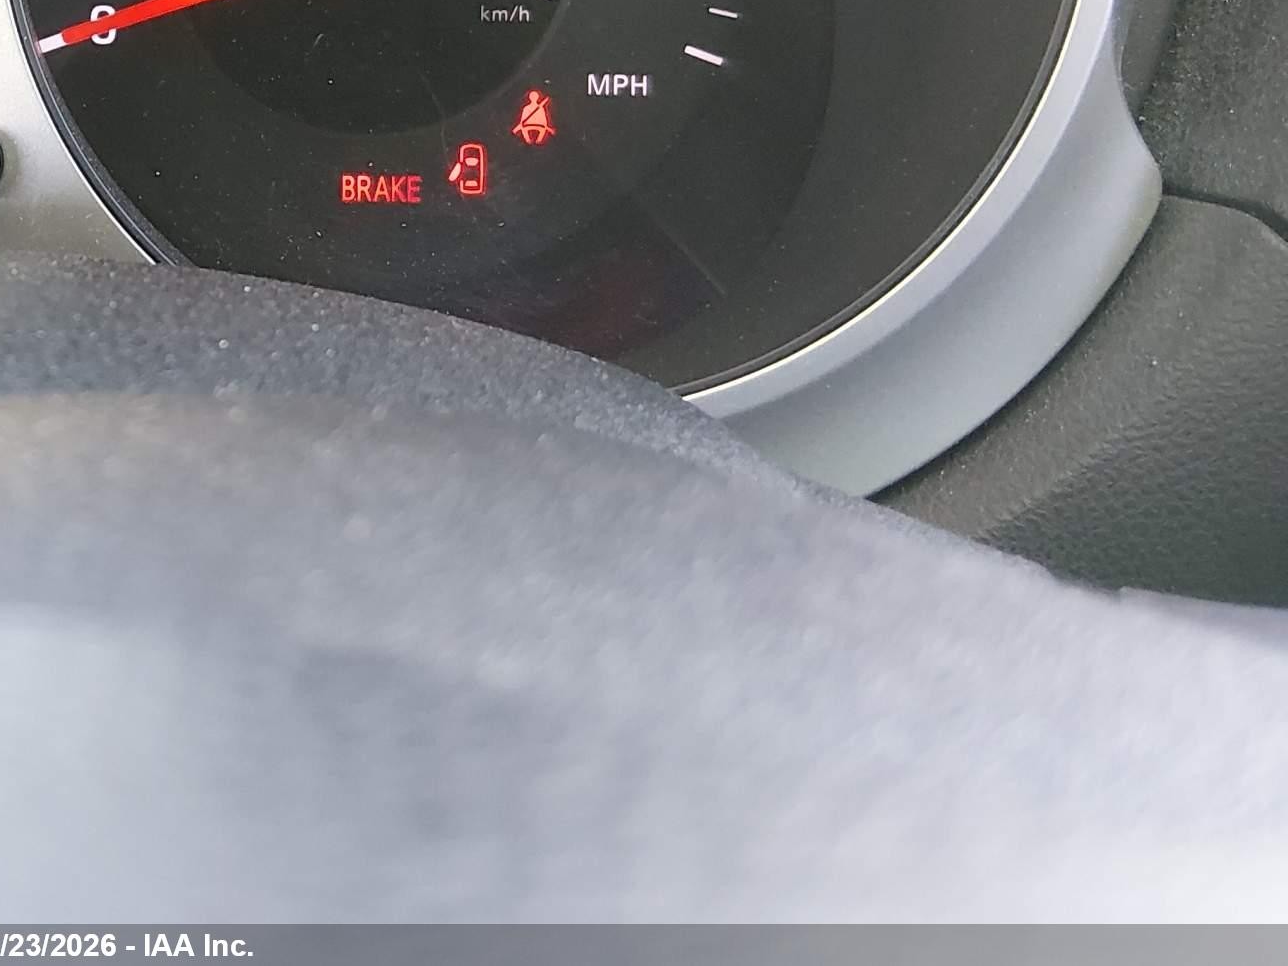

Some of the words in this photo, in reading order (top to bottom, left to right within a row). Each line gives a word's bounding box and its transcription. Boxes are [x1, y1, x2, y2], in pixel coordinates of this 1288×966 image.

[480, 5, 530, 22] km/h
[587, 73, 648, 97] MPH
[341, 175, 421, 202] BRAKE
